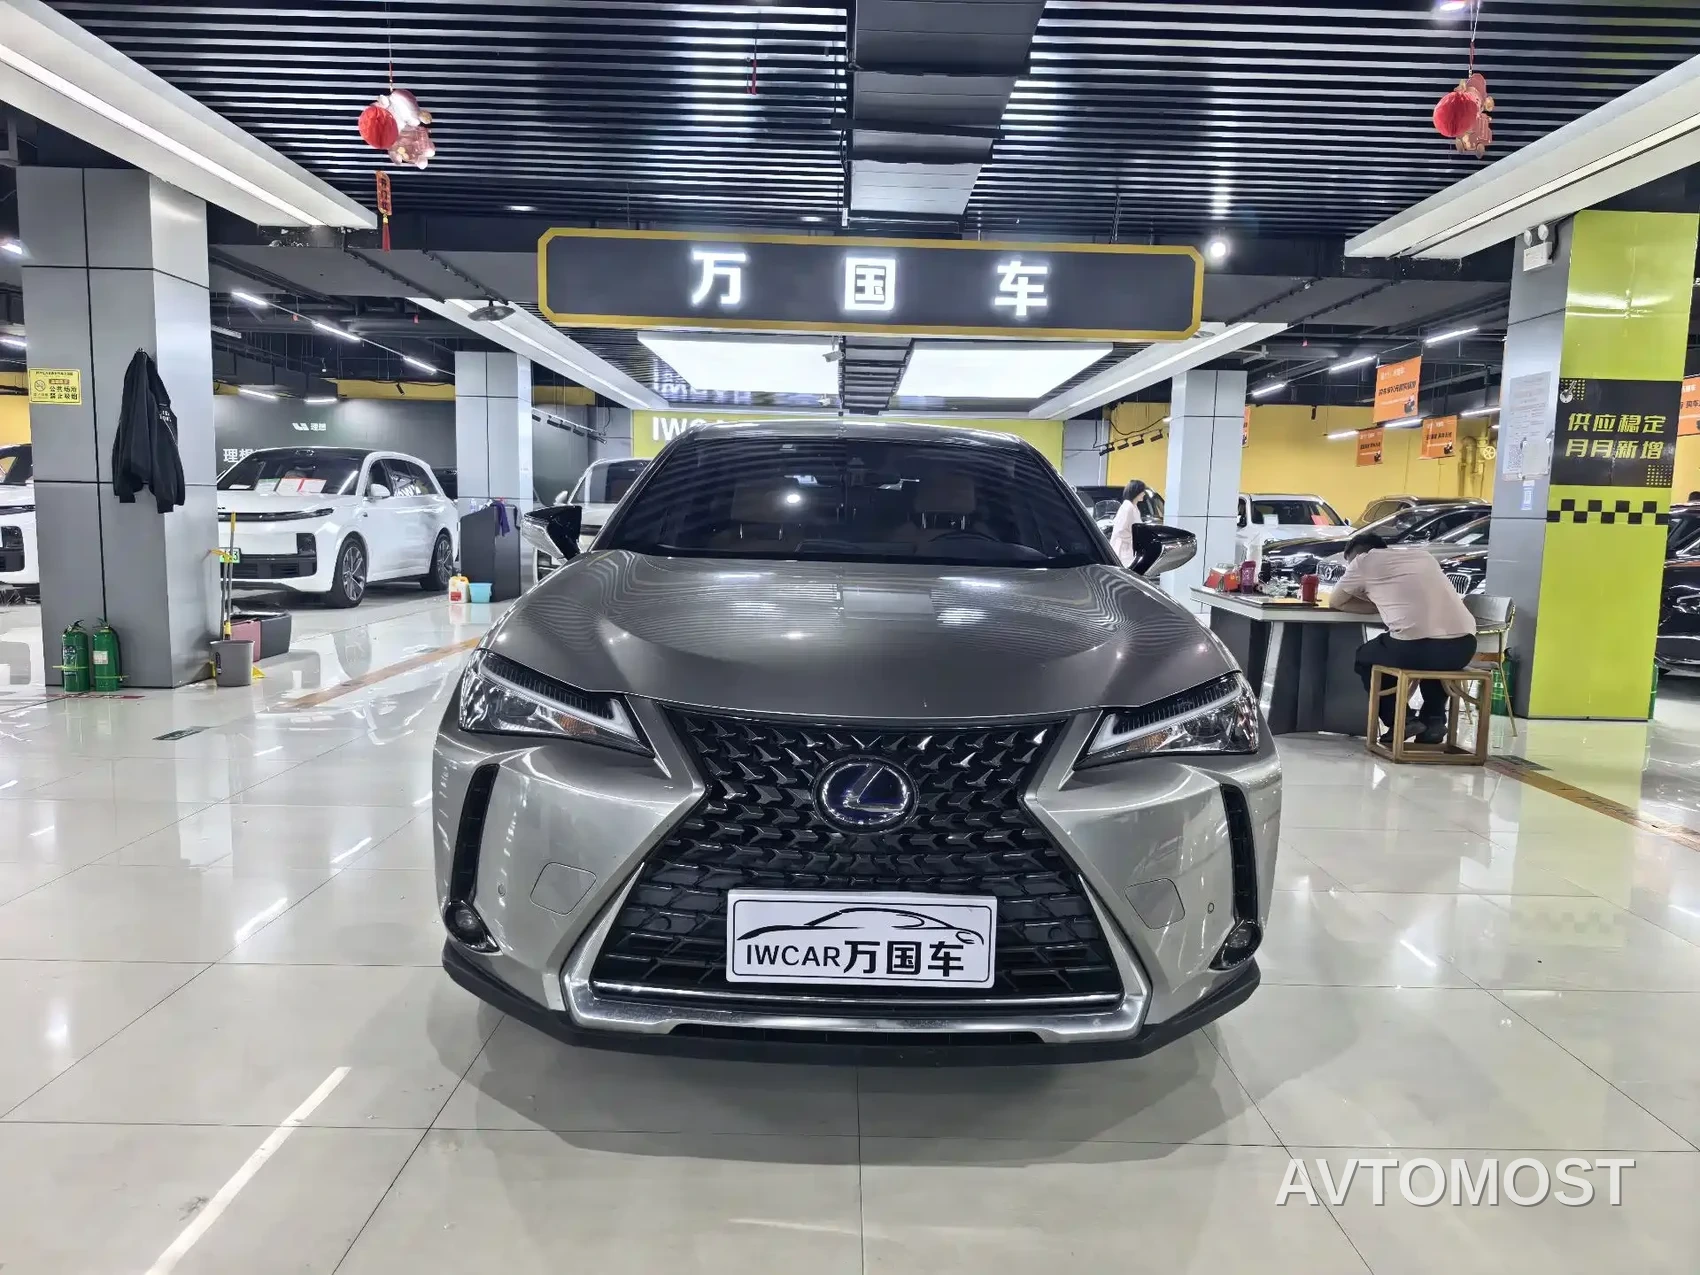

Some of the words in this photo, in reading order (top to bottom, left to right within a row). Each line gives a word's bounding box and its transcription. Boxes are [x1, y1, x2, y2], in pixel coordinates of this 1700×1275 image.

[692, 250, 1048, 317] 万国车
[652, 416, 725, 440] IW
[1567, 413, 1667, 434] 供应稳定
[1565, 438, 1664, 459] 月月新增
[746, 940, 964, 977] IWCAR万国车
